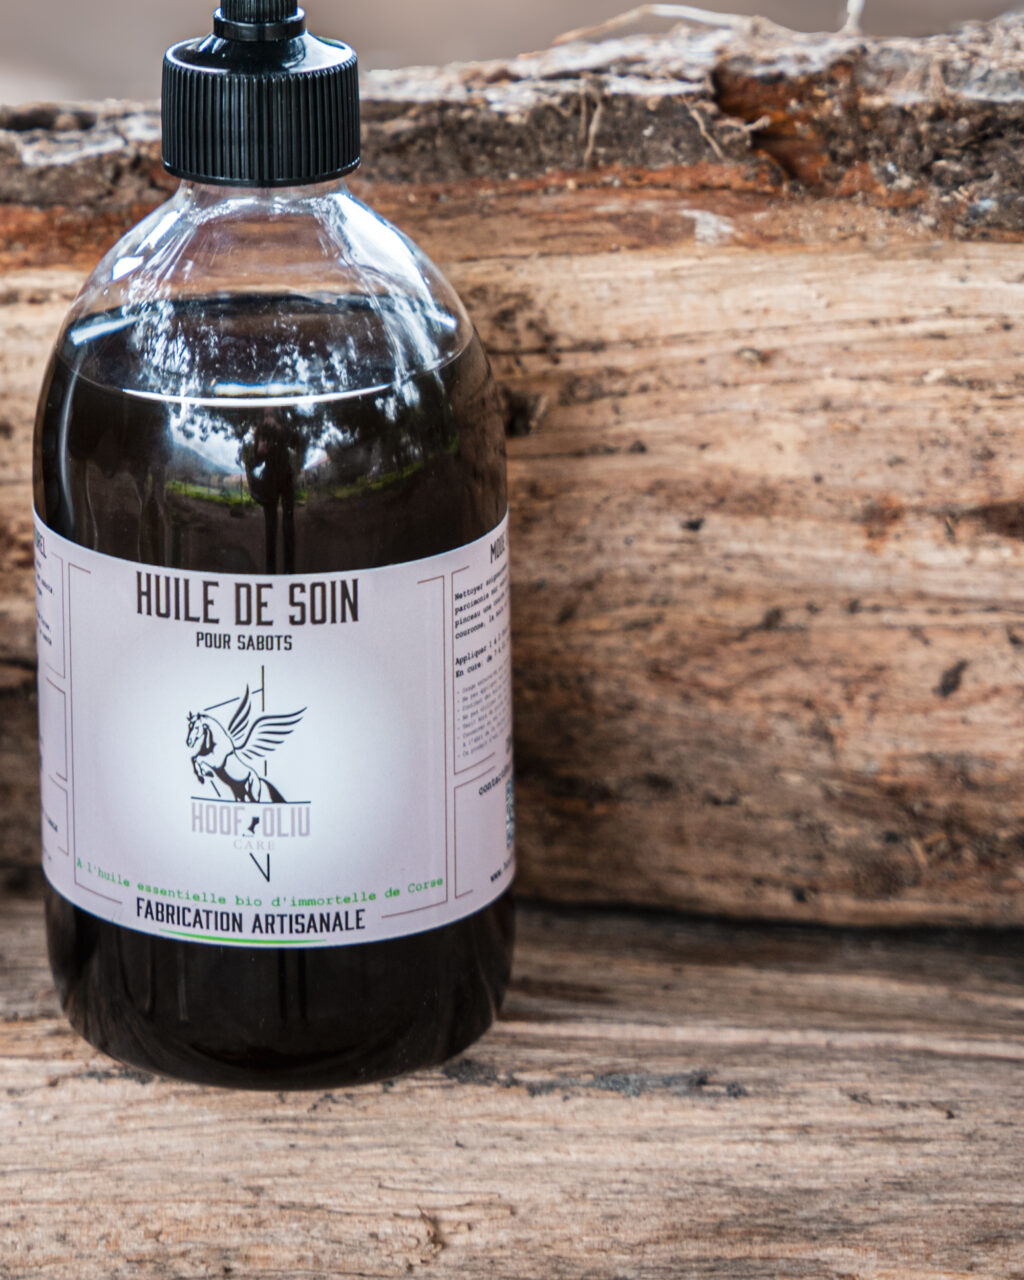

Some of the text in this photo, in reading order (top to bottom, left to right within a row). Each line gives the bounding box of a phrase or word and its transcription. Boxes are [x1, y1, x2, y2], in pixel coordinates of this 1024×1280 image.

[136, 570, 359, 627] HUILE DE SOIN
[195, 631, 293, 651] POUR SABOTS
[190, 801, 312, 837] HOOF OLIU
[232, 839, 275, 851] CARE
[86, 862, 131, 887] l'huile
[137, 882, 227, 905] essentielle
[234, 895, 263, 908] bio
[271, 891, 377, 908] d'immortelle
[384, 886, 401, 899] de
[407, 877, 444, 895] Corse
[136, 896, 366, 935] FABRICATION ARTISANALE
